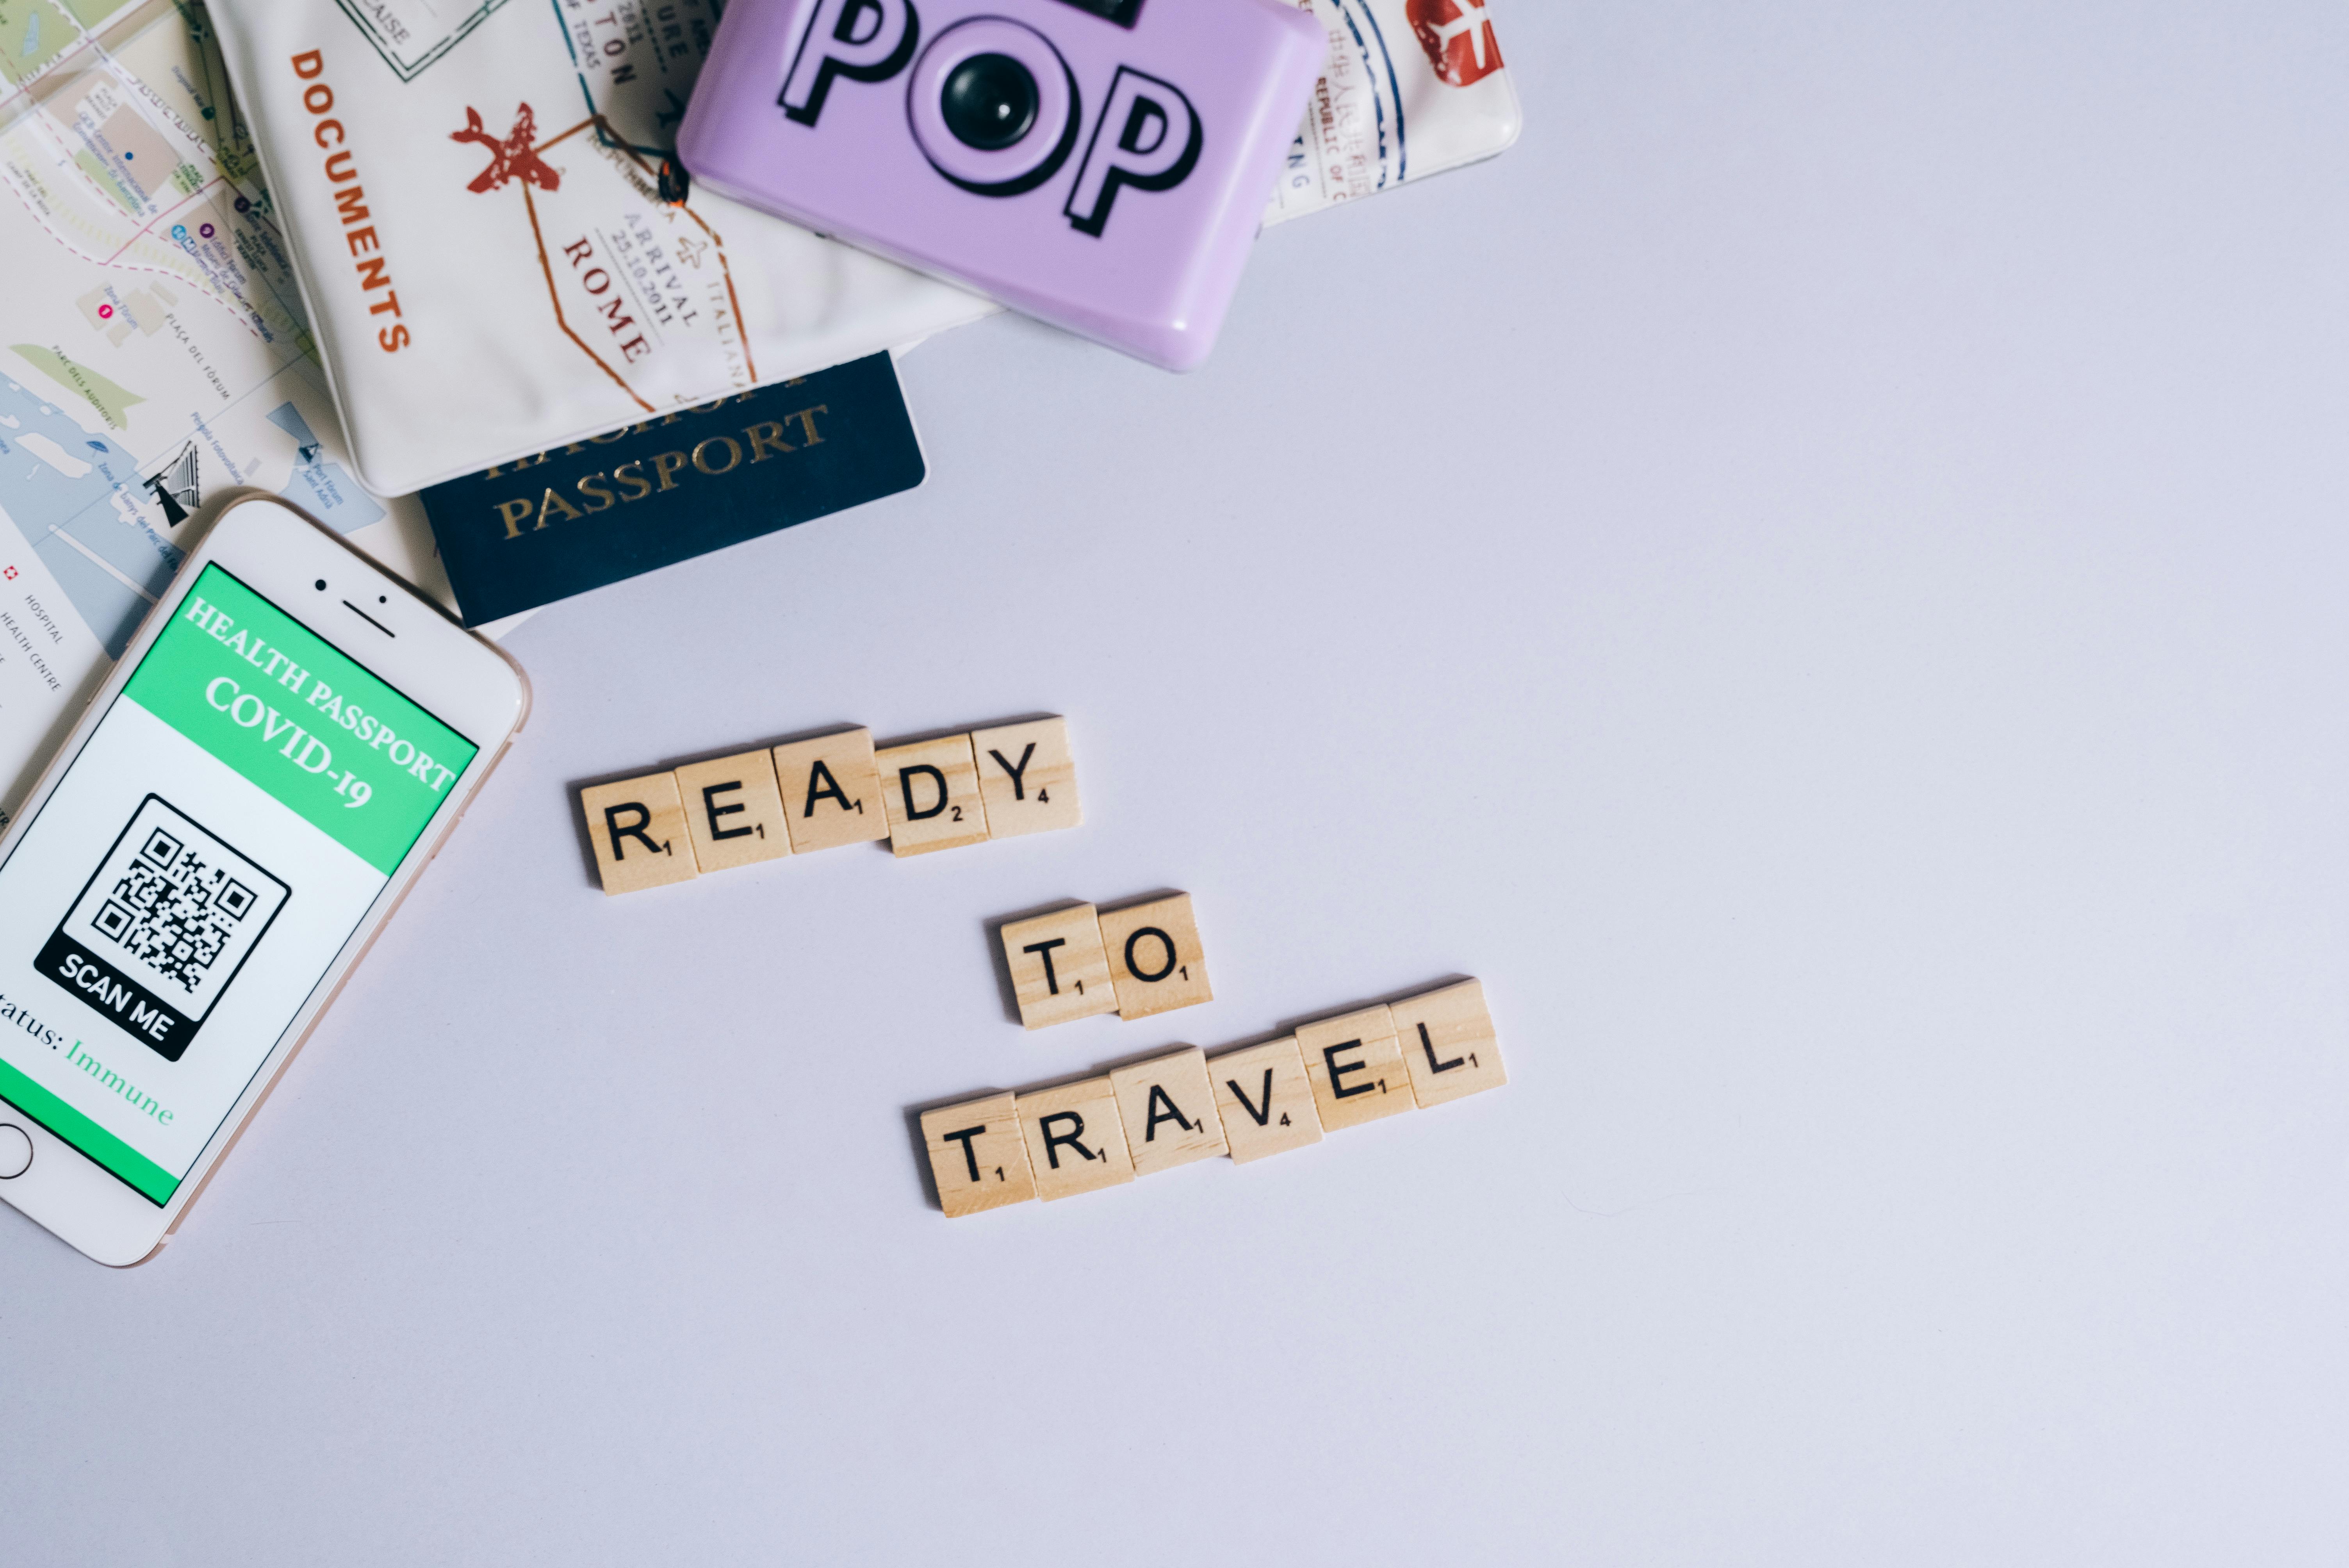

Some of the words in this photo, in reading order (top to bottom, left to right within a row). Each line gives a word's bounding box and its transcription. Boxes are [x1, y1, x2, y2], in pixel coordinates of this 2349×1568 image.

[574, 20, 602, 69] TEXAS
[291, 49, 411, 353] DOCUMENTS
[563, 236, 652, 364] ROME
[612, 230, 675, 326] 25.10.2011
[625, 212, 699, 327] ARRIVAL
[53, 345, 70, 365] PARC
[68, 367, 85, 387] DELS
[84, 388, 117, 431] AUDITORIS
[164, 312, 191, 346] PLAÇA
[188, 345, 205, 364] DEL
[202, 364, 231, 401] FÒRUM
[118, 491, 140, 516] banys
[494, 404, 829, 540] PASSPORT
[1, 611, 33, 652] HEALTH
[30, 653, 61, 692] CENTRE
[25, 594, 63, 645] HOSPITAL
[184, 597, 310, 694] HEALTH
[306, 680, 456, 792] PASSPORT
[205, 676, 373, 809] COVID-19
[604, 743, 1037, 861] READY
[59, 953, 134, 1012] SCAN
[129, 1000, 175, 1041] ME
[1023, 927, 1176, 995] TO
[65, 1039, 175, 1126] Immune
[943, 1023, 1465, 1182] TRAVEL
